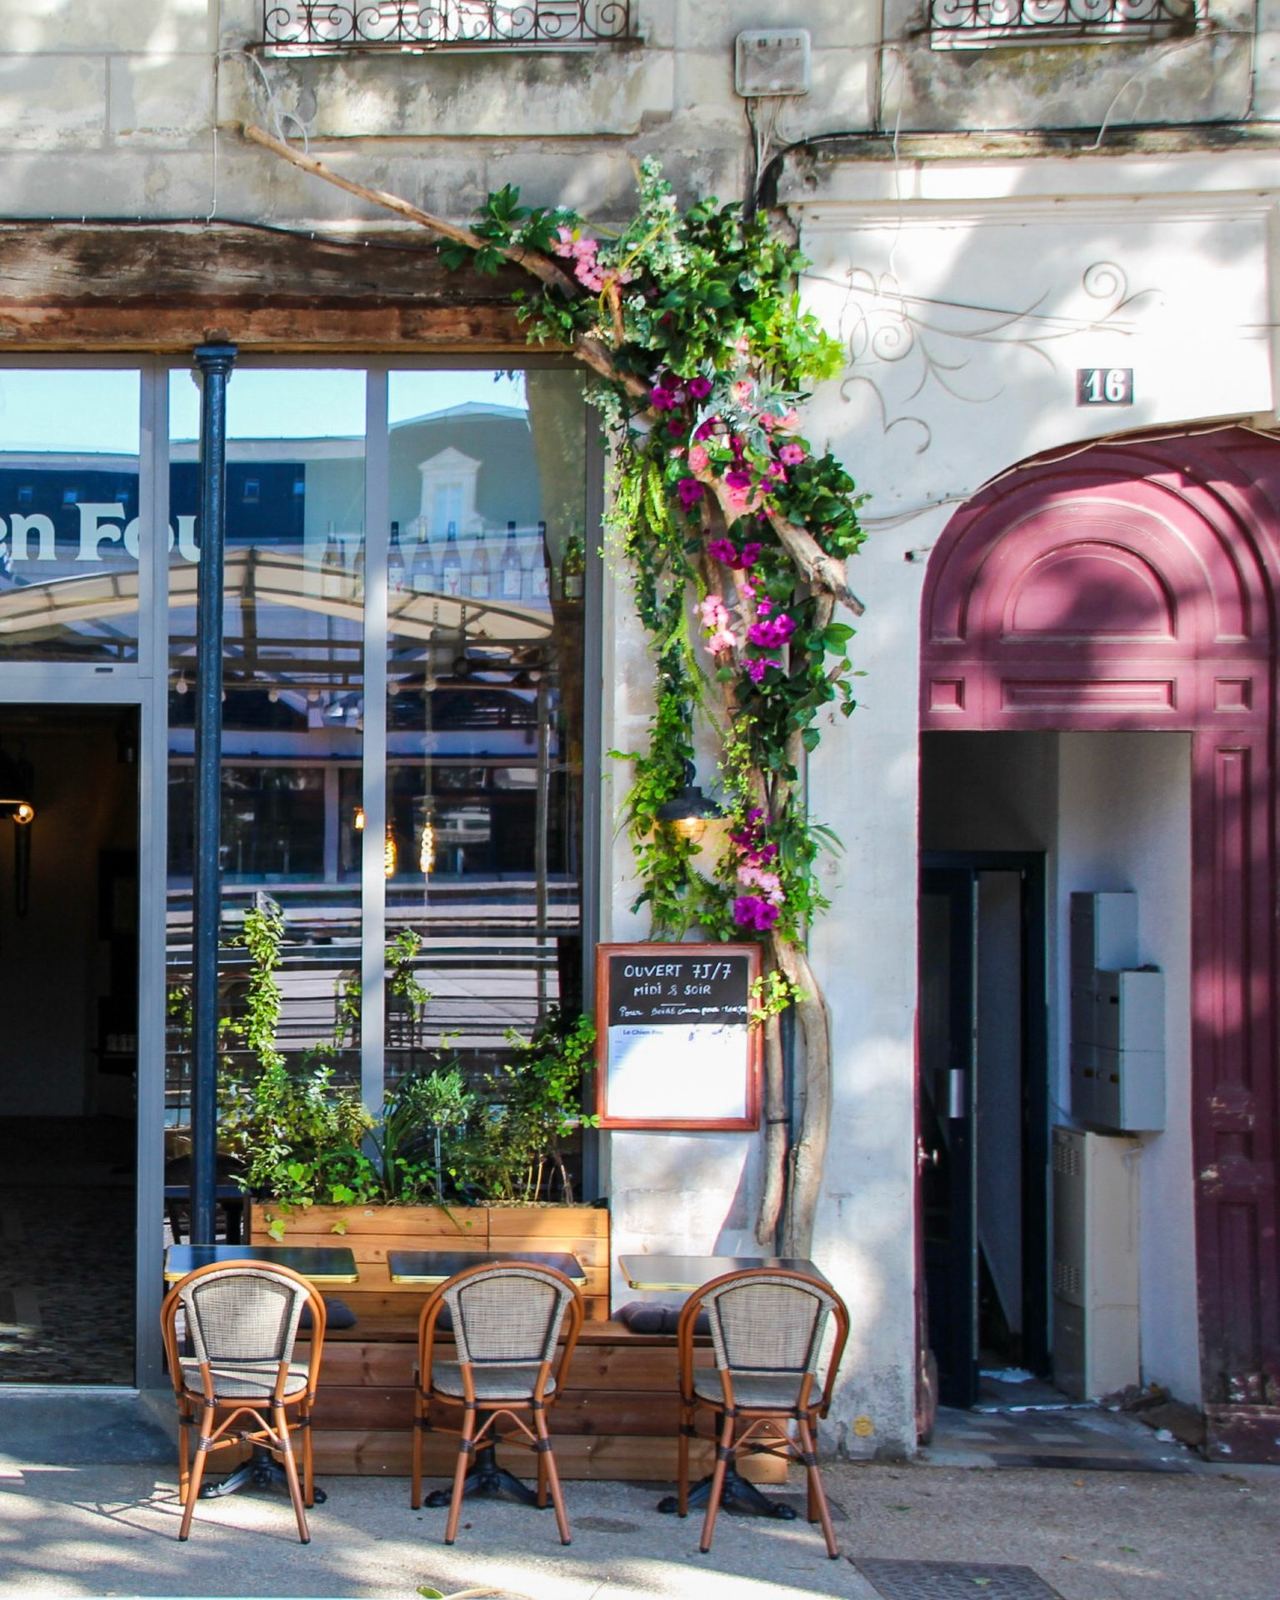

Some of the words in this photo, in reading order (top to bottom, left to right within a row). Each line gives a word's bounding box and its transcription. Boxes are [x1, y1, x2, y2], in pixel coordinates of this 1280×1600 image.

[1084, 369, 1126, 402] 16
[0, 513, 58, 561] n
[623, 964, 683, 978] OUVERT
[691, 962, 732, 981] 7J/7
